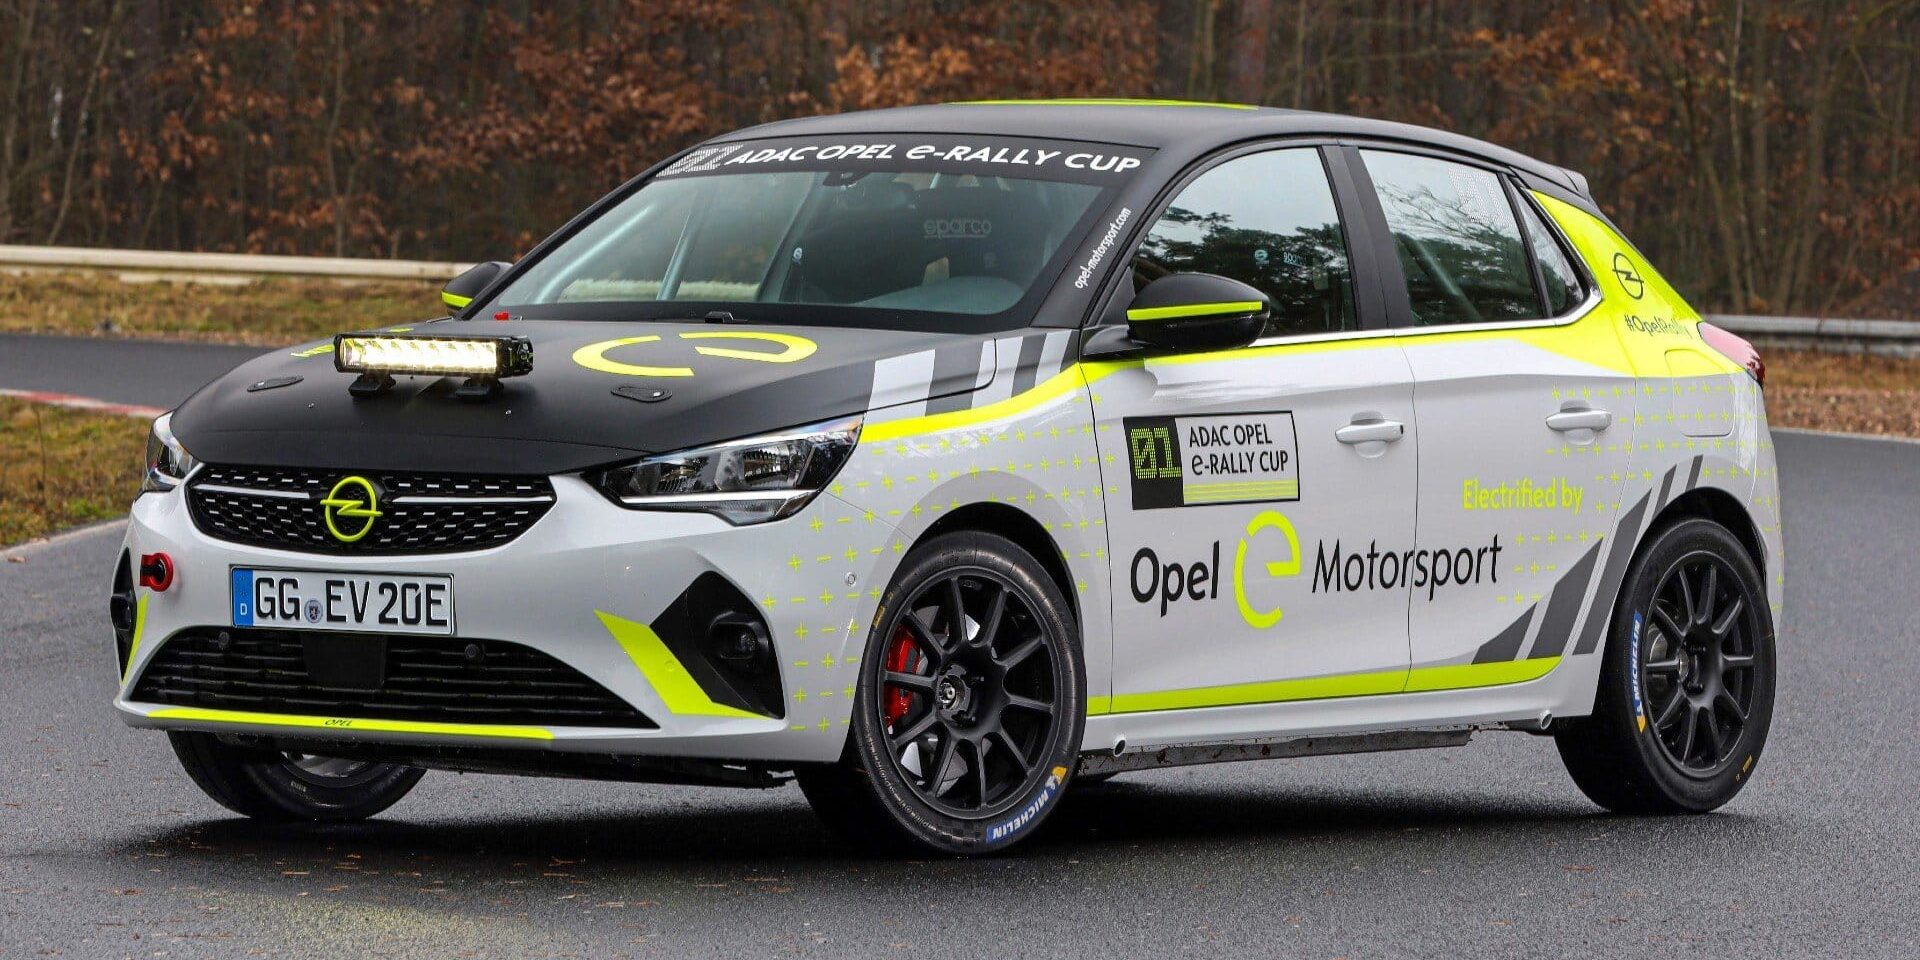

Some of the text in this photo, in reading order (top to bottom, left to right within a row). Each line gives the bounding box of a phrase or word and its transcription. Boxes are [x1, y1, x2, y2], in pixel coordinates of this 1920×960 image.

[724, 146, 819, 166] ADAC
[816, 144, 897, 160] OPEL
[905, 144, 1063, 166] e-RALLY
[1064, 153, 1141, 173] CUP
[1074, 207, 1132, 289] opel-motorsport.com
[1131, 427, 1182, 480] 01
[1189, 423, 1273, 448] ADAC OPEL
[1191, 450, 1289, 476] e-RALLY CUP
[1463, 476, 1584, 516] Electrified by
[1130, 539, 1220, 618] Opel
[1312, 533, 1503, 602] Motorsport
[240, 602, 248, 616] D
[255, 577, 448, 627] GG EV 20E
[992, 789, 1049, 840] MICHELIN
